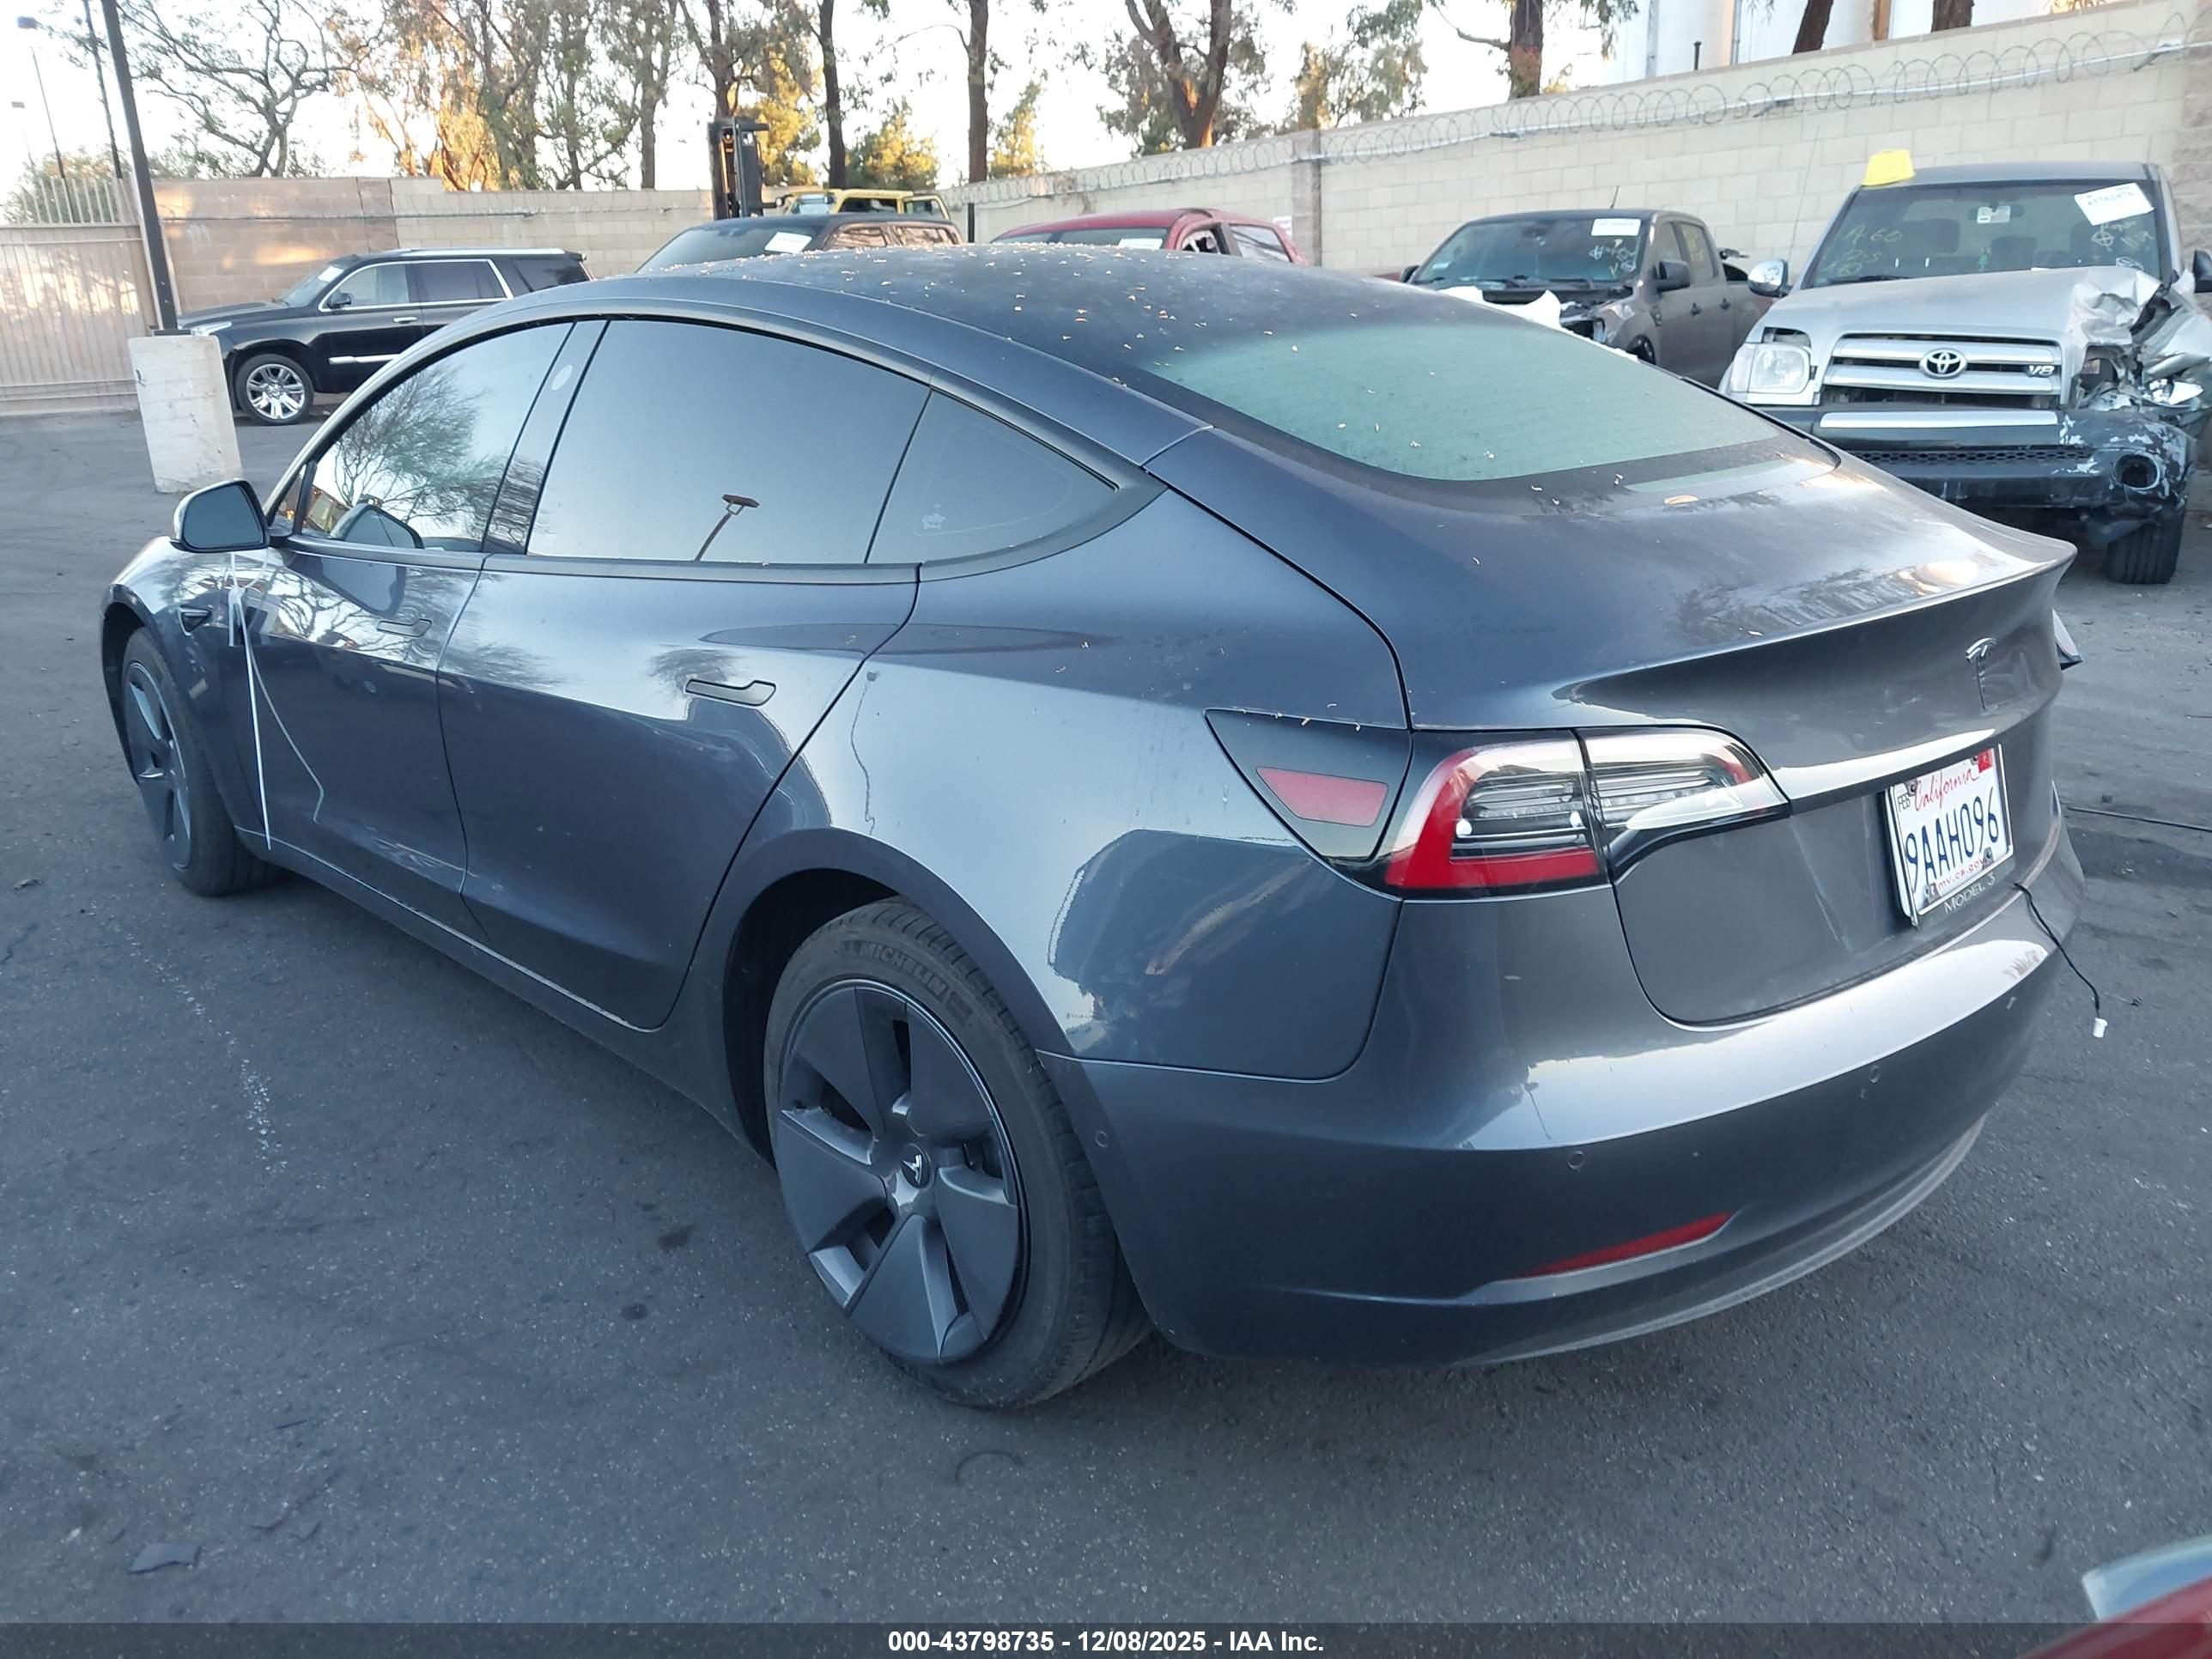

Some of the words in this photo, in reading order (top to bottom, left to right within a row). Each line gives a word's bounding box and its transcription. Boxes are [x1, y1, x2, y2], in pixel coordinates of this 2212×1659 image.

[2028, 365, 2055, 376] V8
[1915, 769, 1979, 811] California
[1905, 786, 1999, 893] 9AAH096
[1936, 858, 1987, 890] mv.ca.gov
[1943, 882, 1985, 914] MODEL
[858, 944, 948, 999] MICHELIN
